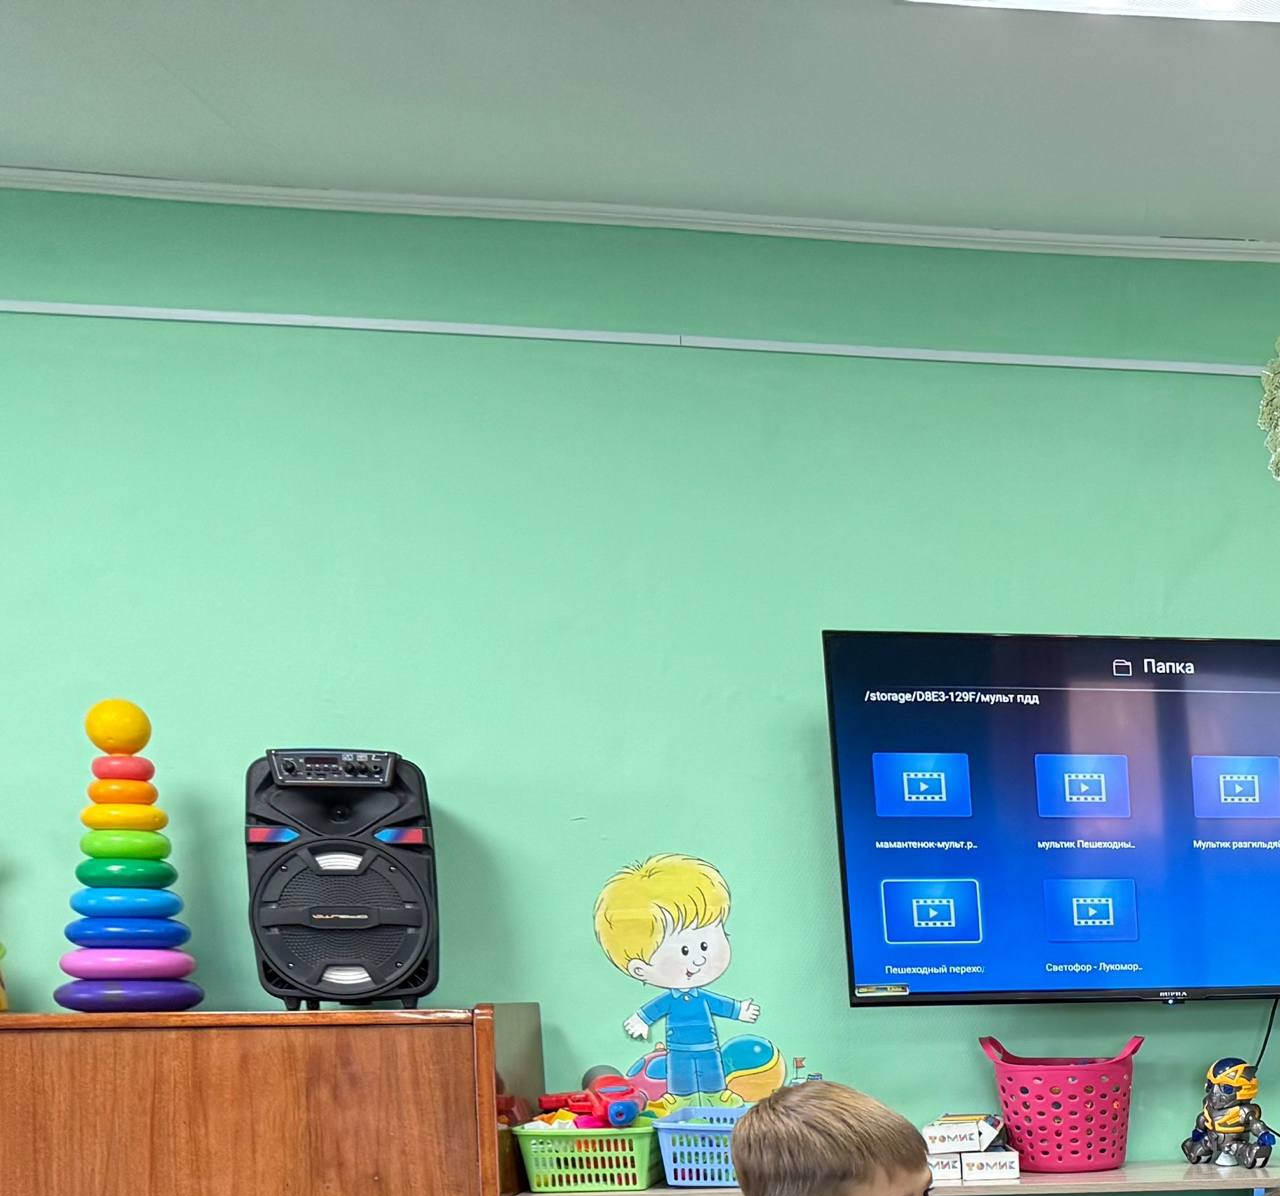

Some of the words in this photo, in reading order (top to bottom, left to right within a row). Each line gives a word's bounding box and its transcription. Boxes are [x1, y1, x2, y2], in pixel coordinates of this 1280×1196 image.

[1142, 658, 1195, 675] Папка
[864, 689, 1014, 705] /storage/D8E3-129F/мульт
[1016, 693, 1040, 705] пдд
[1037, 840, 1076, 850] мультик
[1193, 839, 1231, 850] Мультик
[885, 964, 947, 975] Пешеходный
[949, 965, 985, 975] перехо
[1045, 962, 1092, 974] Светофор
[927, 1133, 976, 1144] ТОМИК
[928, 1160, 958, 1170] МИК
[965, 1160, 1016, 1171] ТОМИК
